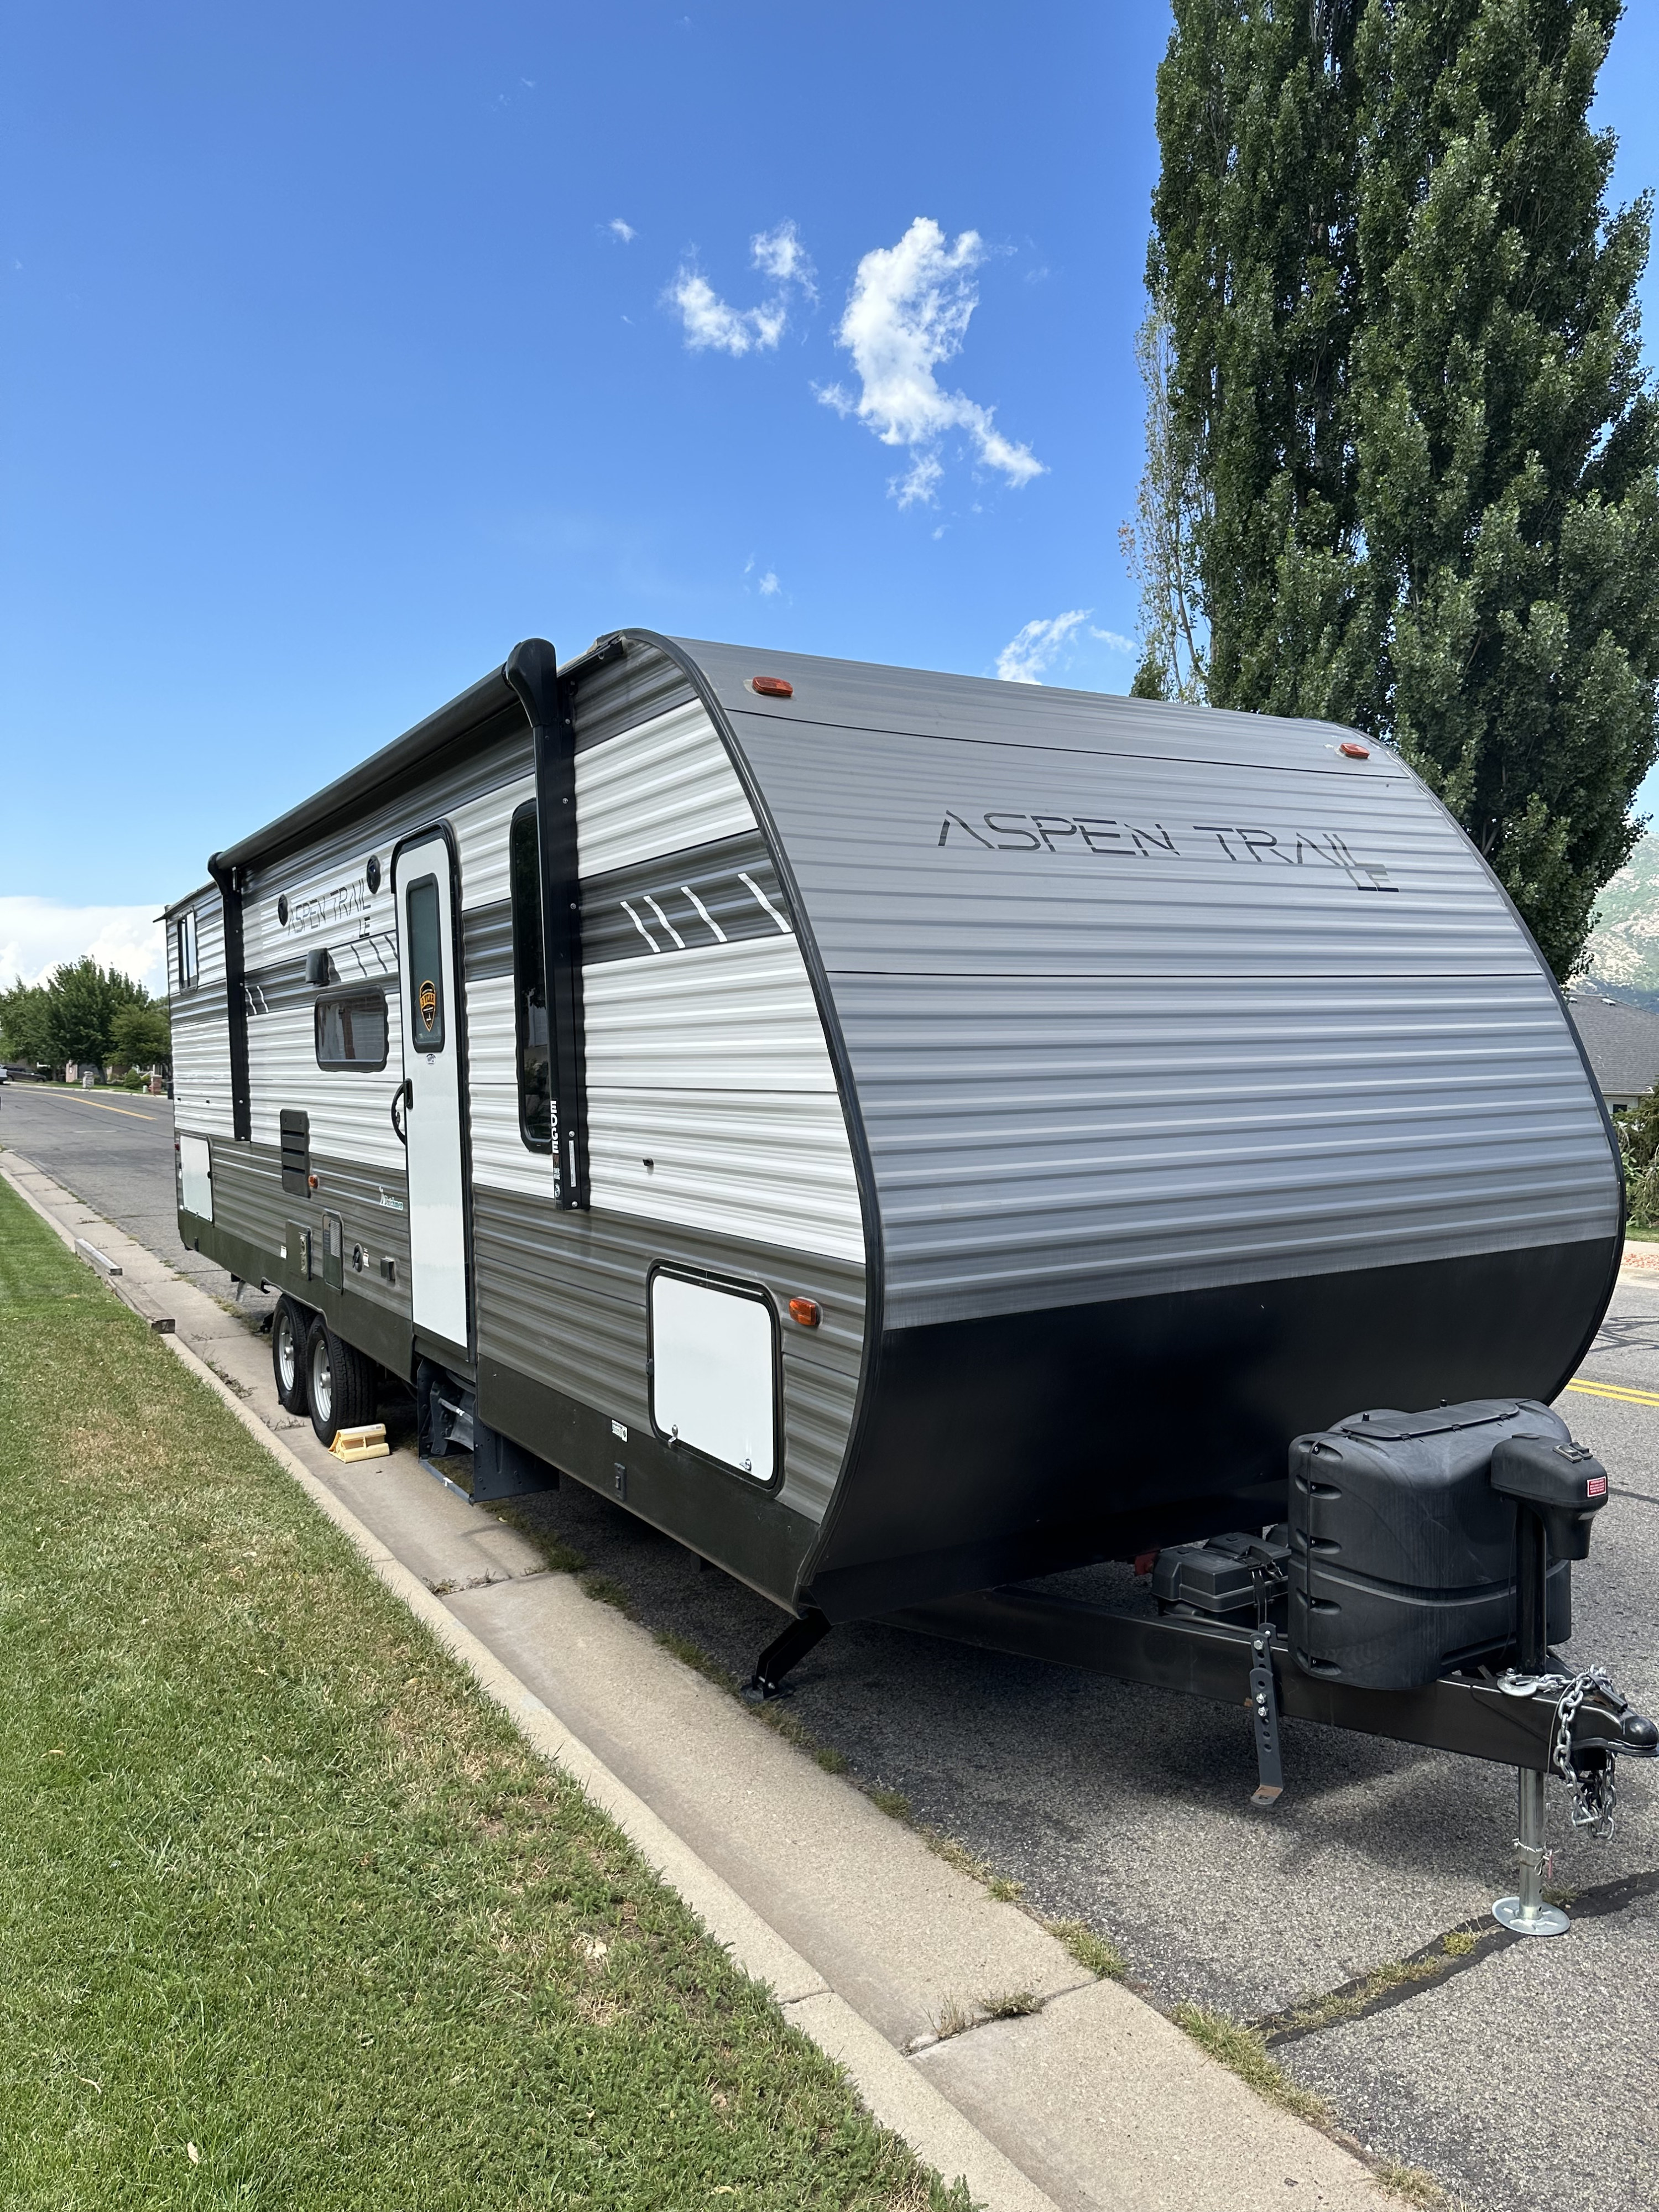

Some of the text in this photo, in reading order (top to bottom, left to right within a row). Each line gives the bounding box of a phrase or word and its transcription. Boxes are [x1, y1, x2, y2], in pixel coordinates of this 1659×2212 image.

[938, 810, 1385, 868] ASPEN TRAIL
[288, 878, 372, 936] ASPEN TRAIL
[359, 916, 371, 938] LE
[550, 1100, 559, 1154] EDGE
